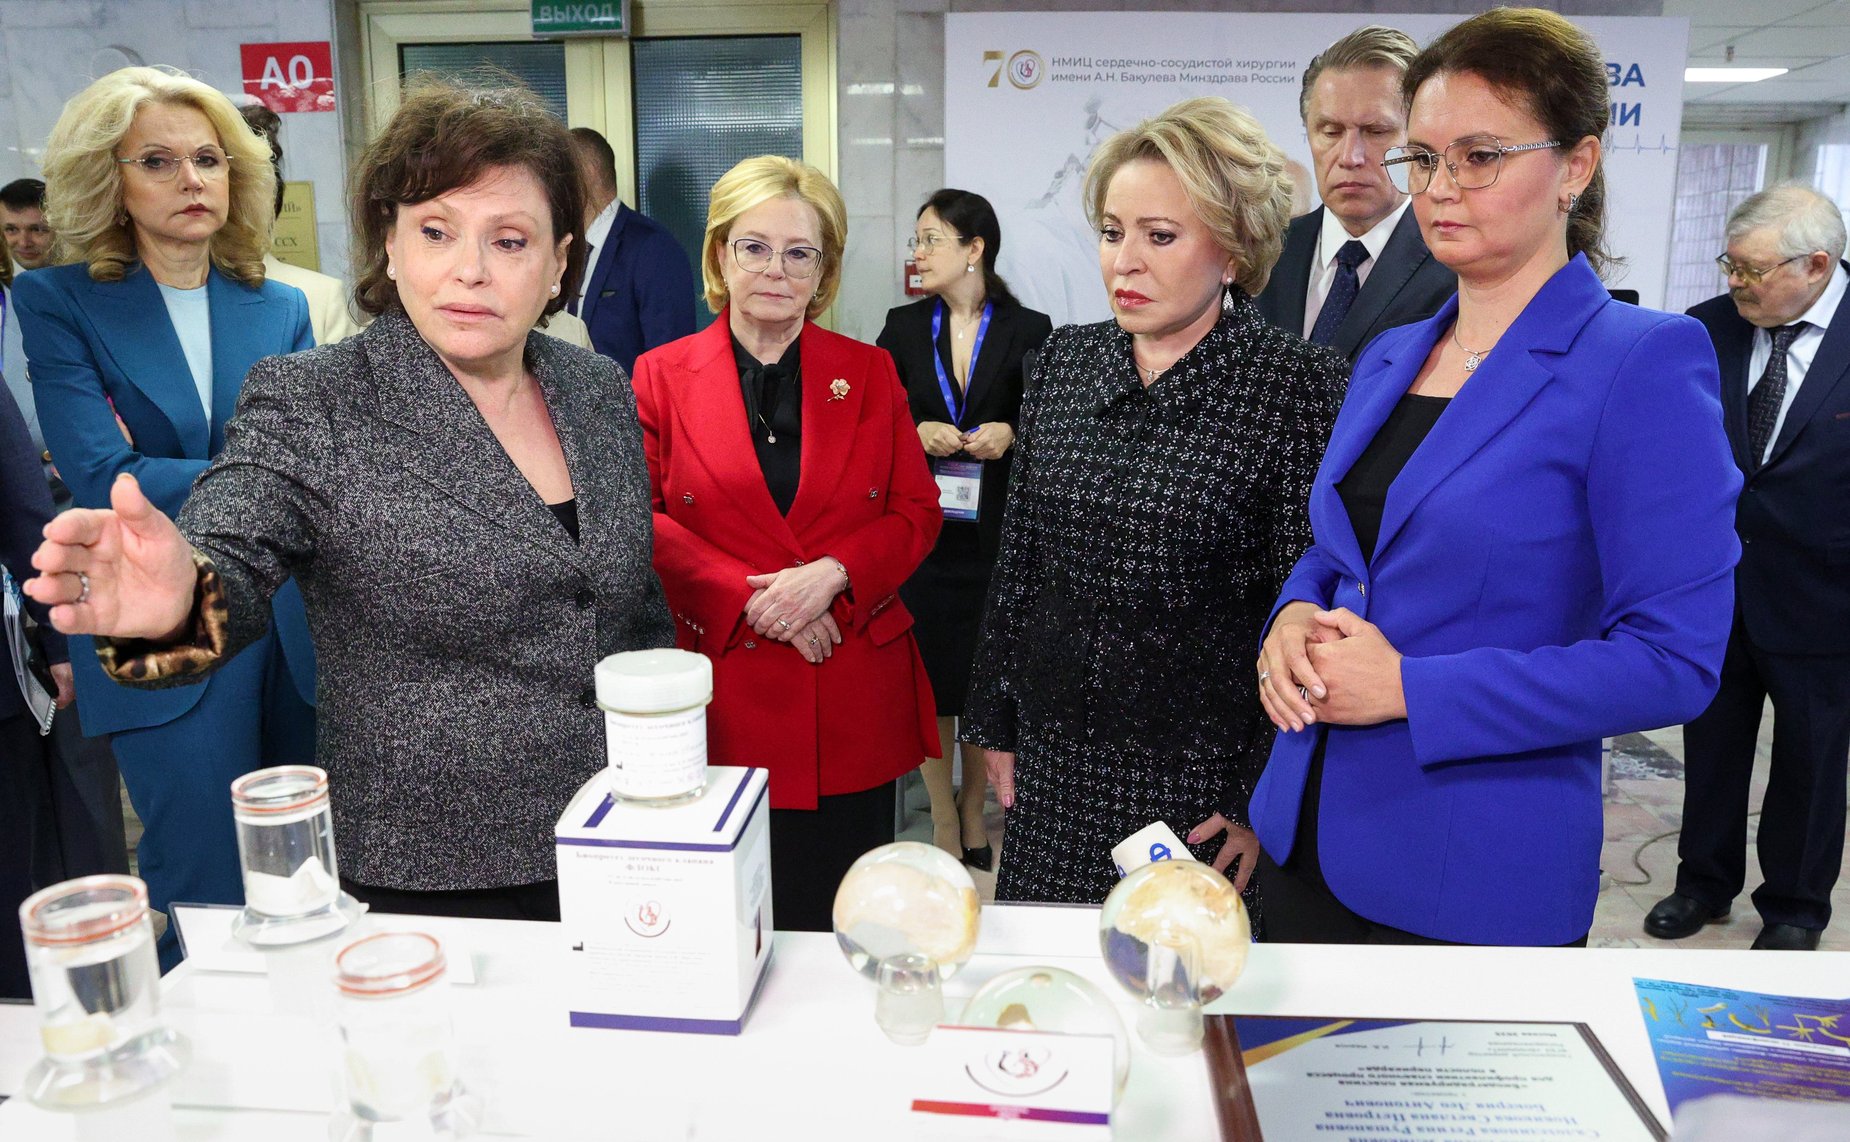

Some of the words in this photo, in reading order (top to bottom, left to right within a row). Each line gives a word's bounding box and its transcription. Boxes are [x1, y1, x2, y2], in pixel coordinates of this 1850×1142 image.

[540, 4, 615, 24] ВЫХОД
[1051, 57, 1093, 69] НМИЦ
[1095, 57, 1233, 70] сердечно-сосудистой
[1236, 60, 1296, 71] хирургии
[1051, 73, 1092, 83] имени
[1094, 72, 1118, 82] А.Н.
[1120, 72, 1177, 84] Бакулева
[1179, 73, 1248, 85] Минздрава
[1251, 73, 1296, 84] России
[1605, 63, 1646, 87] ВА
